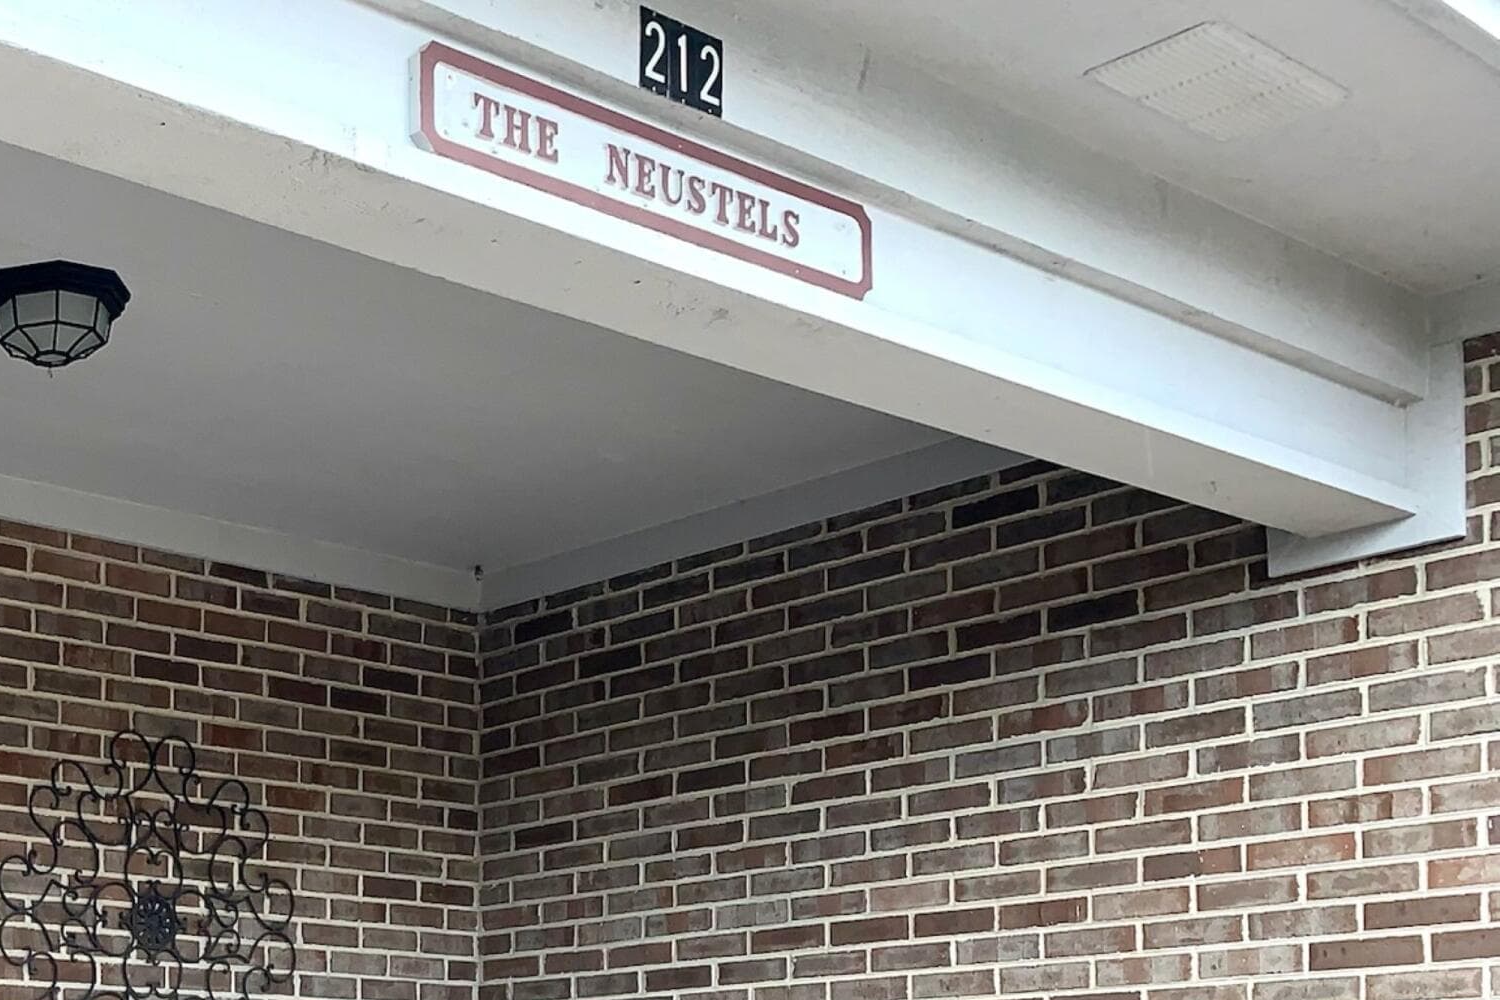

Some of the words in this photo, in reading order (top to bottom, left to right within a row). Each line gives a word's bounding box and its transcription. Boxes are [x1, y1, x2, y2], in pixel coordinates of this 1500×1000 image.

[644, 20, 720, 106] 212
[473, 92, 560, 165] THE
[604, 142, 801, 249] NEUSTELS
